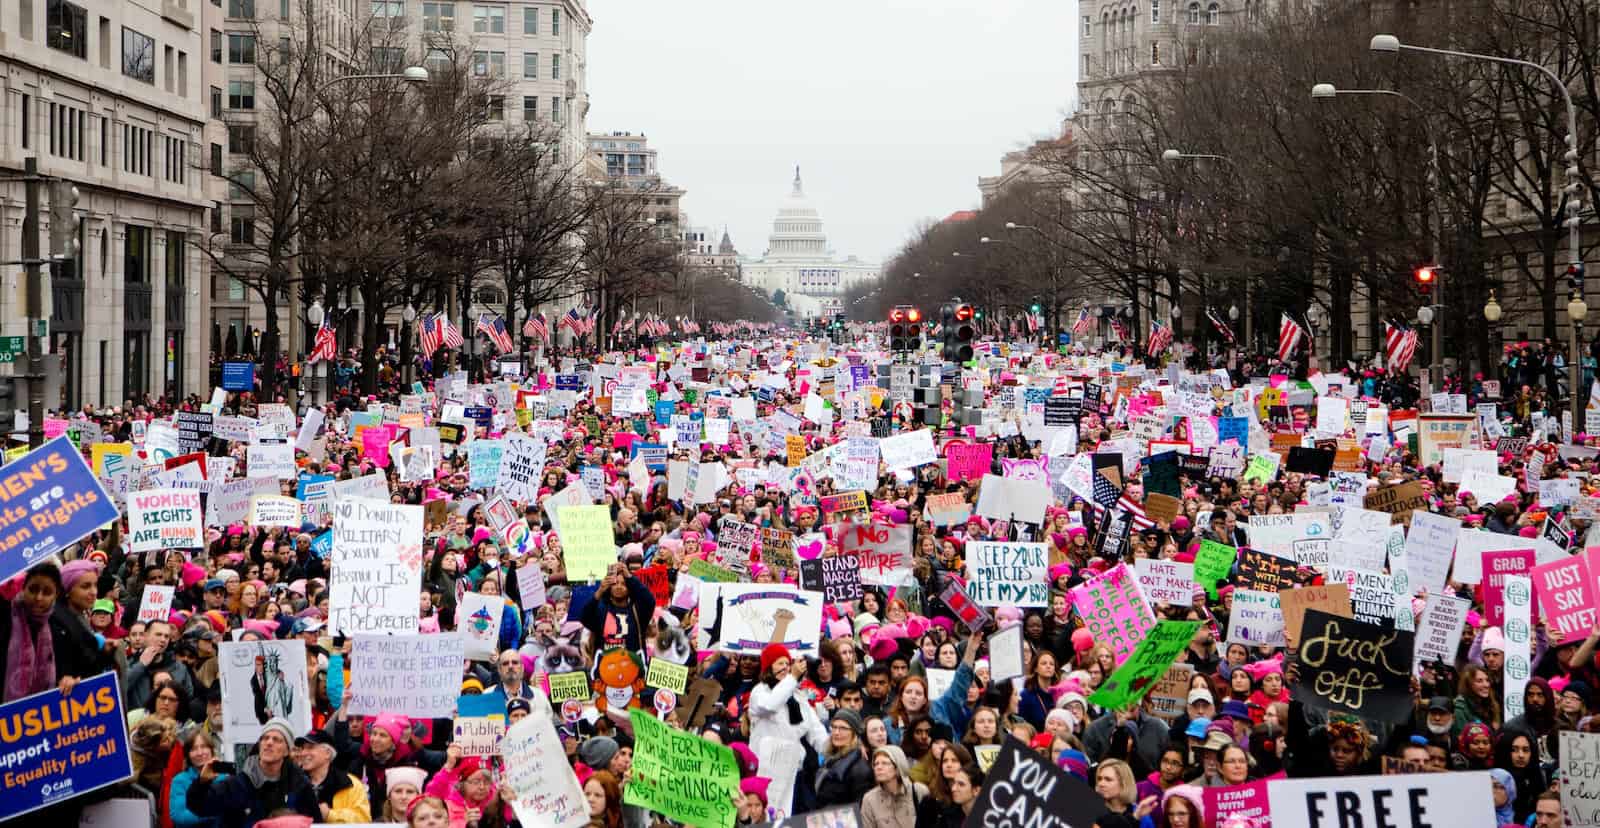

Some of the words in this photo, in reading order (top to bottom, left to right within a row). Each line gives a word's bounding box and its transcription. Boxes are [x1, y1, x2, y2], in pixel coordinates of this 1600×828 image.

[509, 461, 534, 476] WITH
[0, 452, 68, 502] EN'S
[510, 472, 529, 485] HER
[30, 485, 64, 511] are
[31, 490, 98, 532] Rights
[142, 508, 193, 525] RIGHTS
[335, 503, 353, 518] NO
[133, 528, 160, 543] ARE
[161, 527, 196, 538] HUMAN
[334, 520, 402, 544] MILITARY
[856, 524, 888, 547] NO
[161, 537, 194, 547] RIGHTS
[822, 555, 858, 572] STAND
[976, 545, 1010, 566] KEEP
[1011, 546, 1046, 567] YOUR
[1492, 556, 1526, 572] GRAB
[977, 566, 1033, 581] POLICIES
[1150, 563, 1176, 576] HATE
[1255, 571, 1281, 584] WITH
[1543, 564, 1582, 590] JUST
[823, 571, 861, 586] MARCH
[1166, 578, 1192, 590] MAKE
[352, 584, 391, 606] NOT
[826, 583, 863, 600] RISE
[968, 581, 994, 601] OFF
[998, 583, 1029, 603] MY
[1554, 587, 1586, 611] SAY
[1354, 602, 1394, 618] HUMAN
[1429, 613, 1459, 623] THINGS
[1434, 605, 1458, 616] MANY
[1428, 620, 1456, 631] WRONG
[1554, 607, 1597, 634] NYET
[1430, 636, 1447, 645] ONE
[1431, 629, 1448, 638] FOR
[353, 640, 372, 653] WE
[378, 641, 409, 656] MUST
[415, 641, 433, 654] ALL
[356, 655, 377, 669] THE
[359, 674, 396, 690] WHAT
[403, 675, 417, 690] IS
[420, 671, 457, 689] RIGHT
[380, 697, 409, 709] WHAT
[416, 697, 428, 709] IS
[0, 687, 116, 743] USLIMS
[463, 722, 500, 736] Public
[0, 738, 50, 768] upport
[54, 725, 106, 749] Justice
[671, 735, 697, 757] FOR
[699, 741, 720, 762] MY
[5, 759, 66, 788] Equality
[70, 751, 92, 767] for
[97, 739, 117, 759] All
[709, 762, 731, 778] ME
[1009, 749, 1057, 802] YOU
[659, 766, 731, 802] FEMINISM
[1223, 788, 1256, 801] STAND
[1217, 800, 1245, 810] WITH
[1305, 787, 1433, 828] FREE
